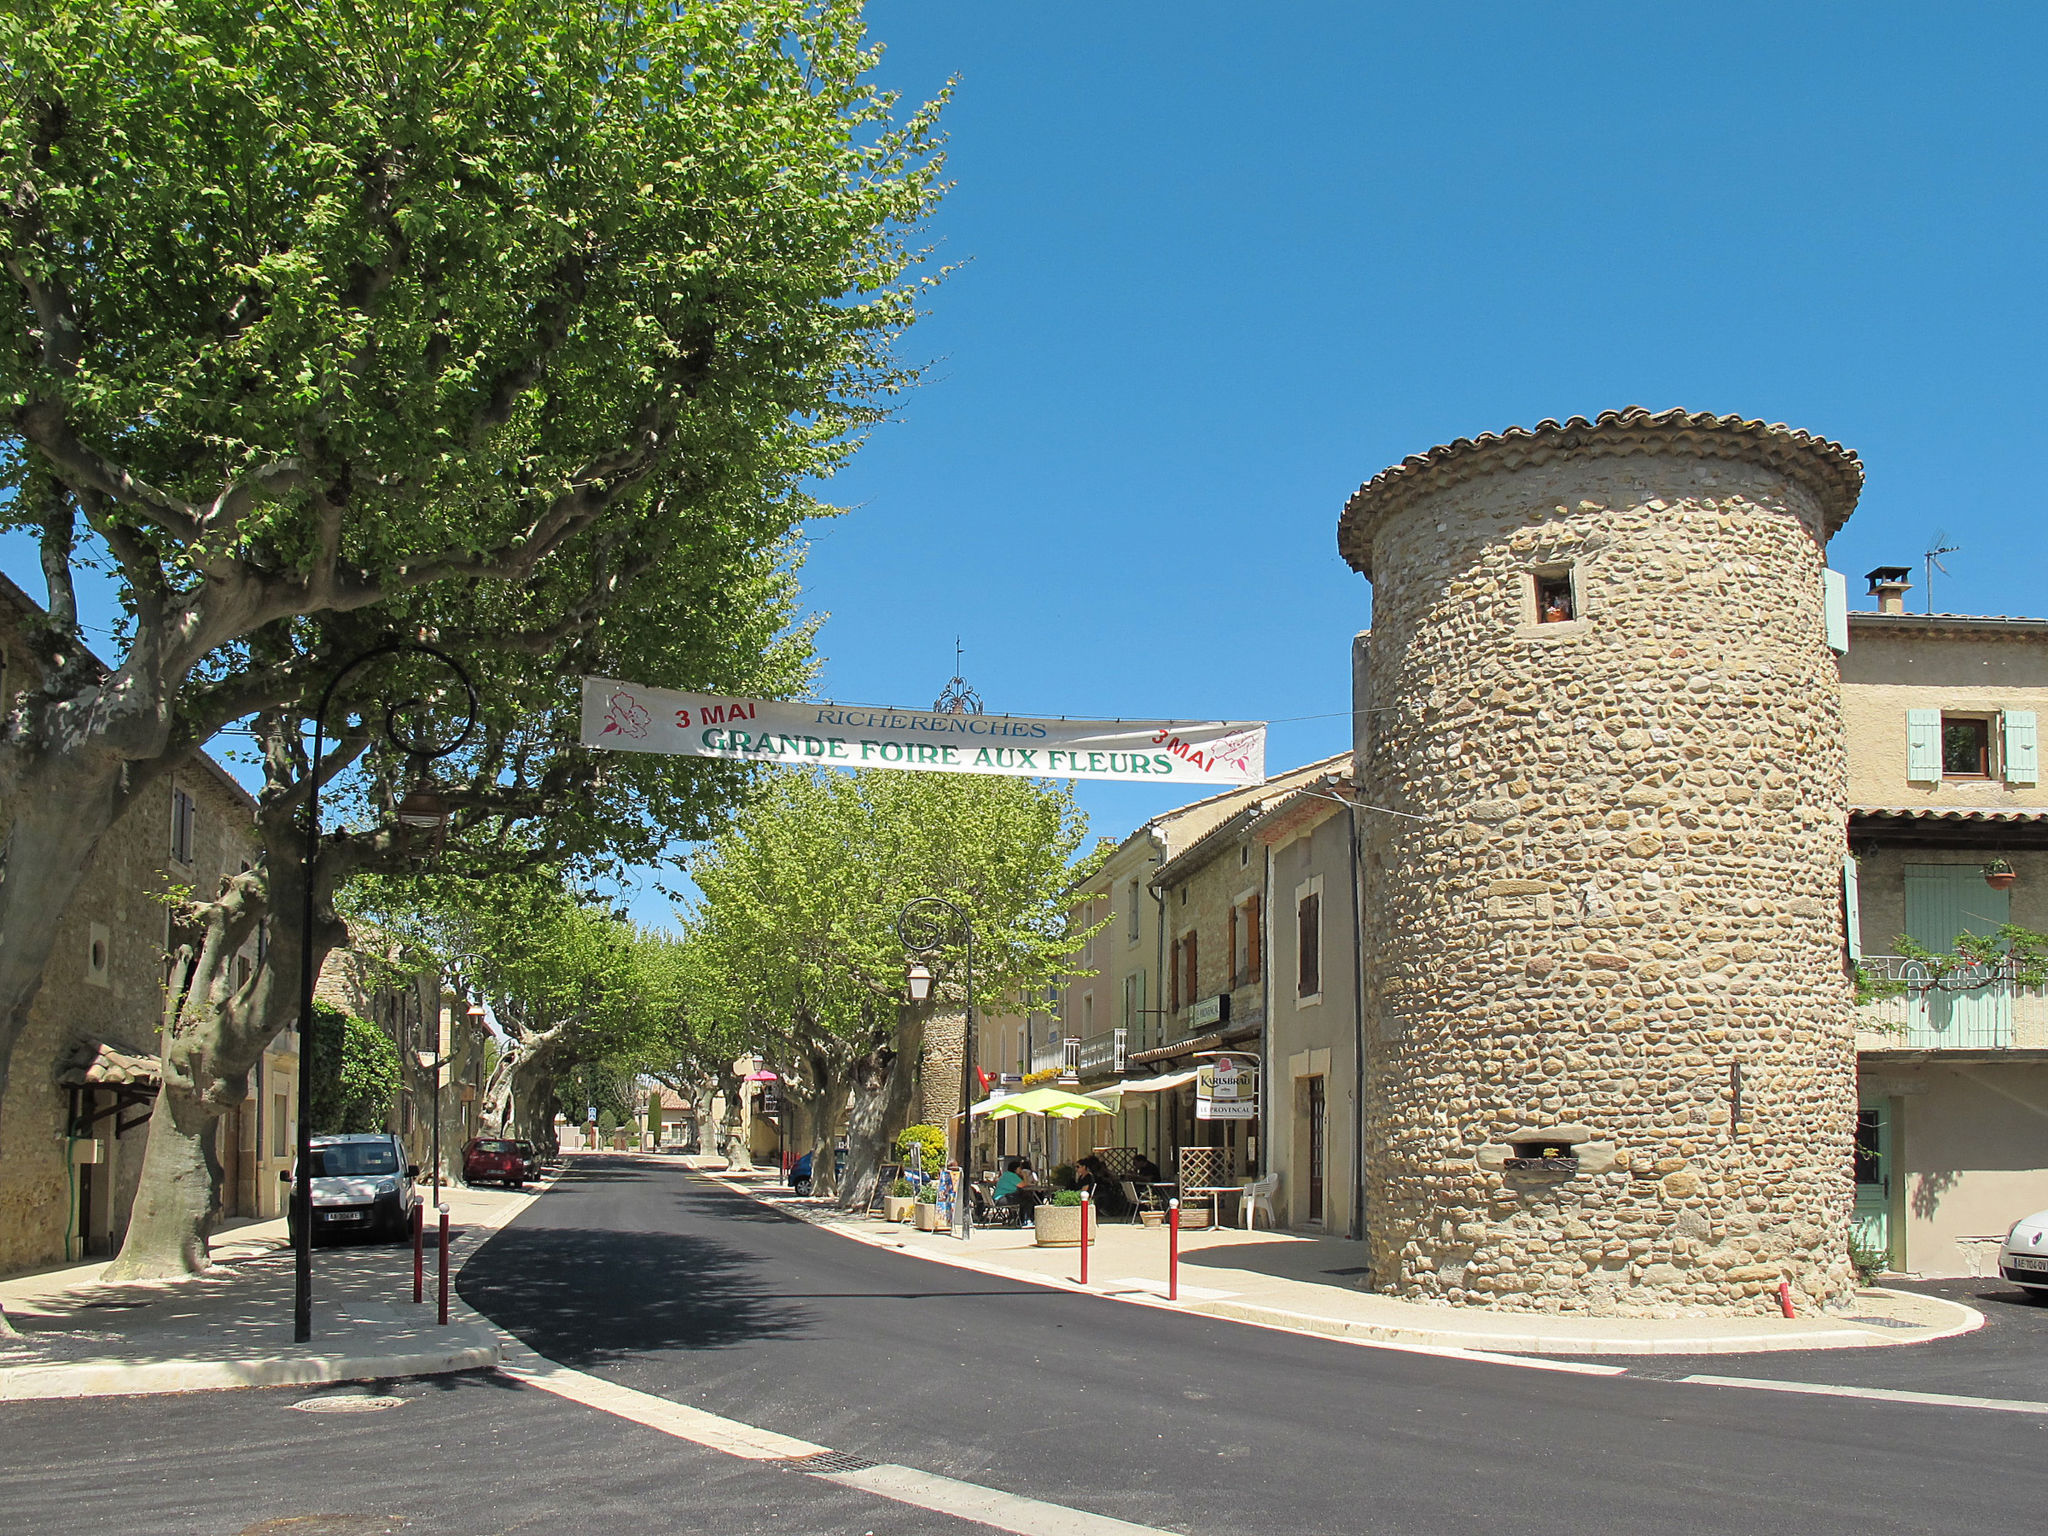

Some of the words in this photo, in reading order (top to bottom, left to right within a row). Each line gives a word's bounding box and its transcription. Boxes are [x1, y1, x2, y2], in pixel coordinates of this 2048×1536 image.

[675, 710, 691, 729] 3
[700, 702, 756, 726] MAI
[815, 709, 1047, 739] RICHERENCHES
[701, 728, 849, 759] GRANDE
[860, 739, 962, 766] FOIRE
[973, 746, 1038, 769] AUX
[1048, 750, 1173, 775] FLEURS
[1151, 729, 1169, 744] 3
[1166, 737, 1216, 773] MAI
